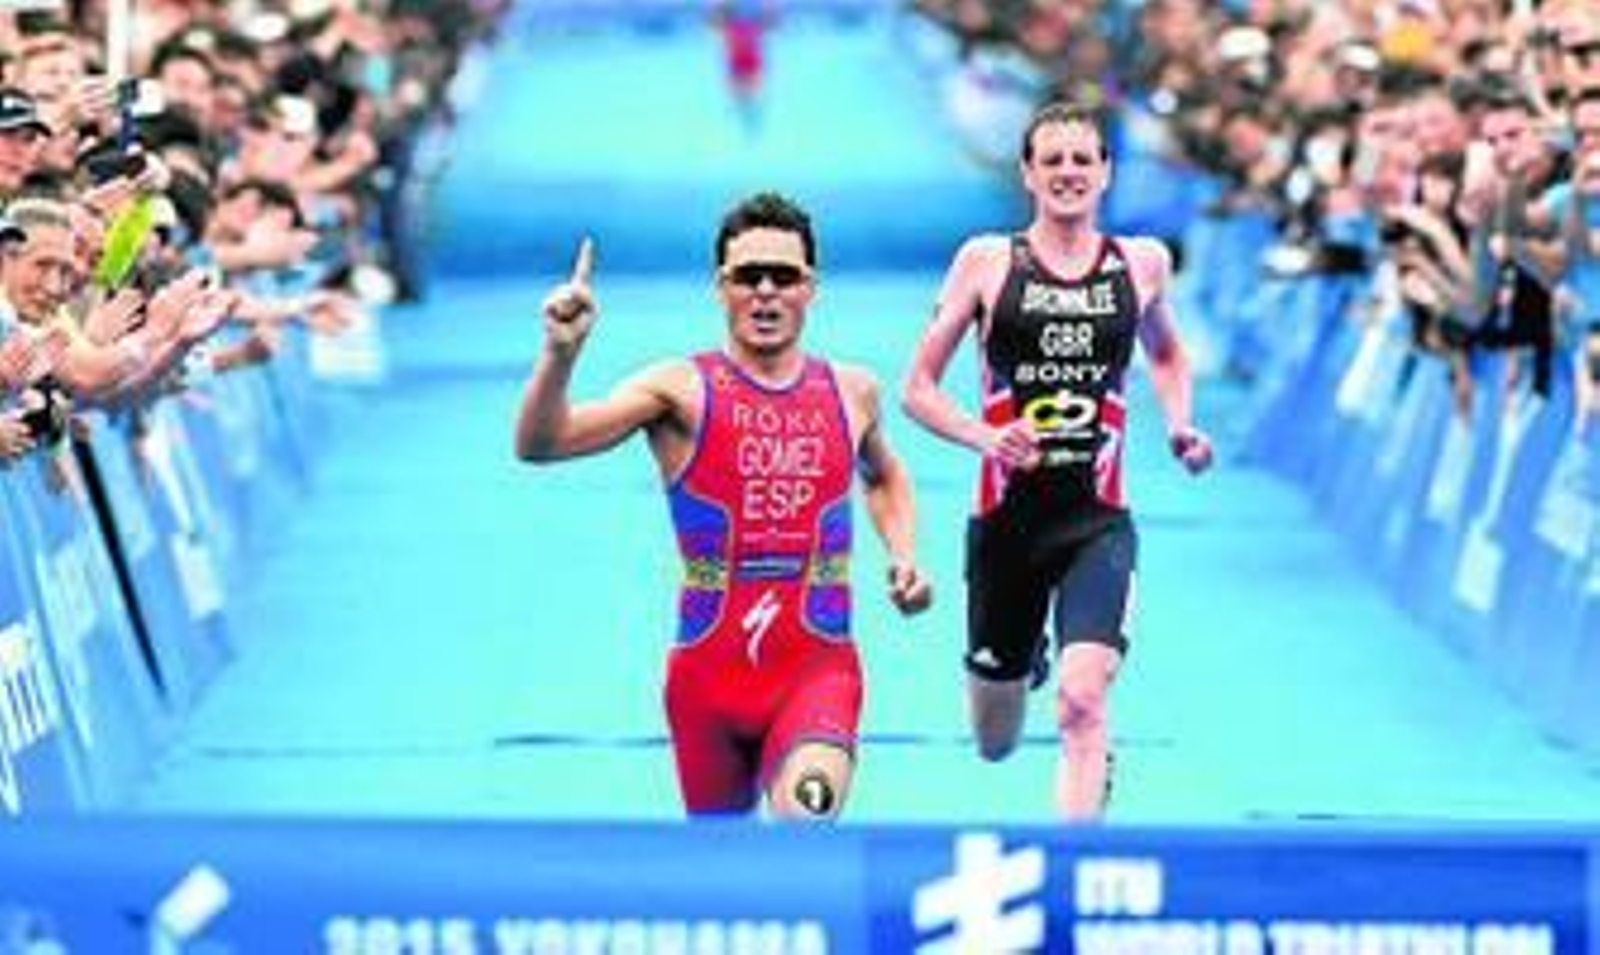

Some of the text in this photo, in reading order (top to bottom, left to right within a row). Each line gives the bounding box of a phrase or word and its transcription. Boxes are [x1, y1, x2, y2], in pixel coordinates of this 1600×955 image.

[1040, 321, 1093, 357] GBR
[733, 403, 831, 434] ROKA
[738, 437, 825, 476] GOMEZ
[743, 480, 815, 519] ESP
